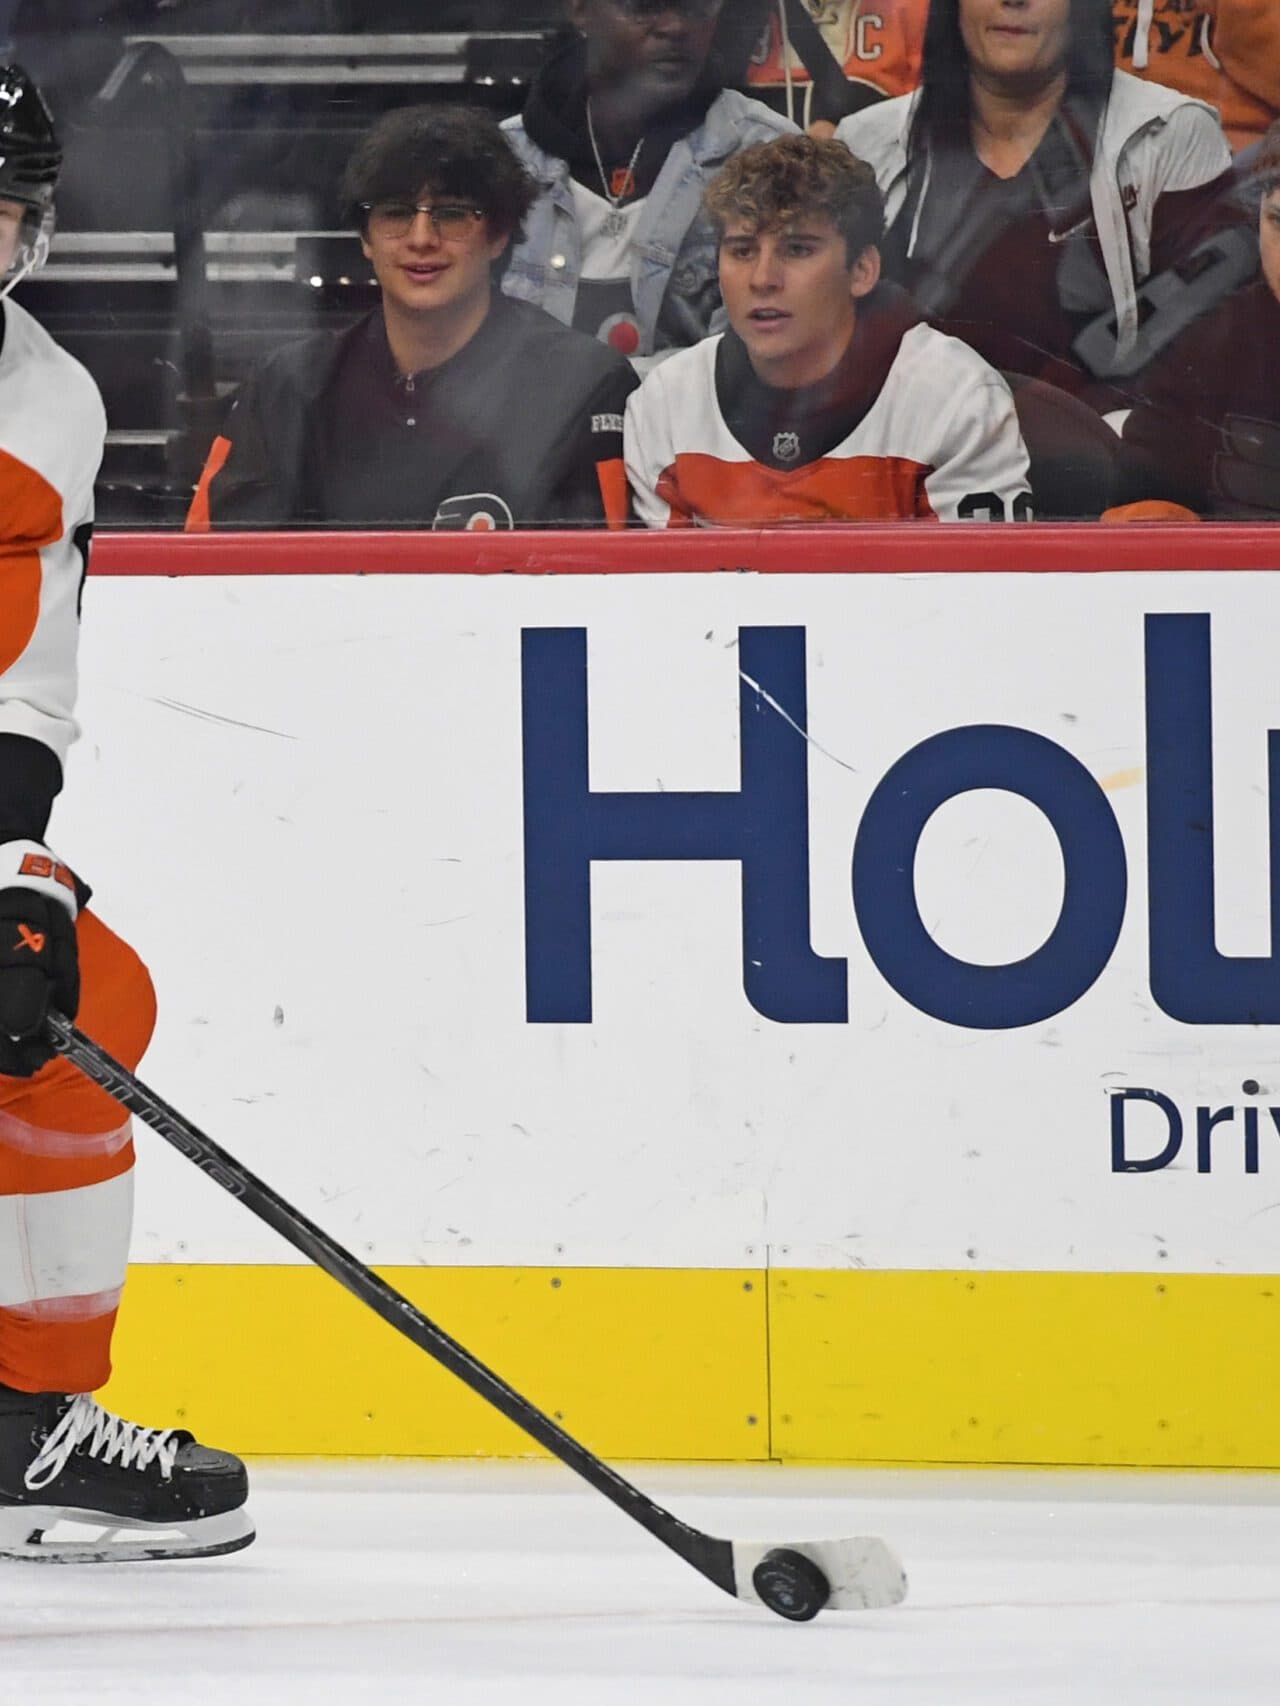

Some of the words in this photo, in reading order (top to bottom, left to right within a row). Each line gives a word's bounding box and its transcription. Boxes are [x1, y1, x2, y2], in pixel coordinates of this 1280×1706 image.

[857, 14, 883, 60] C
[521, 612, 1280, 1029] Hol
[1110, 1079, 1280, 1173] Dri
